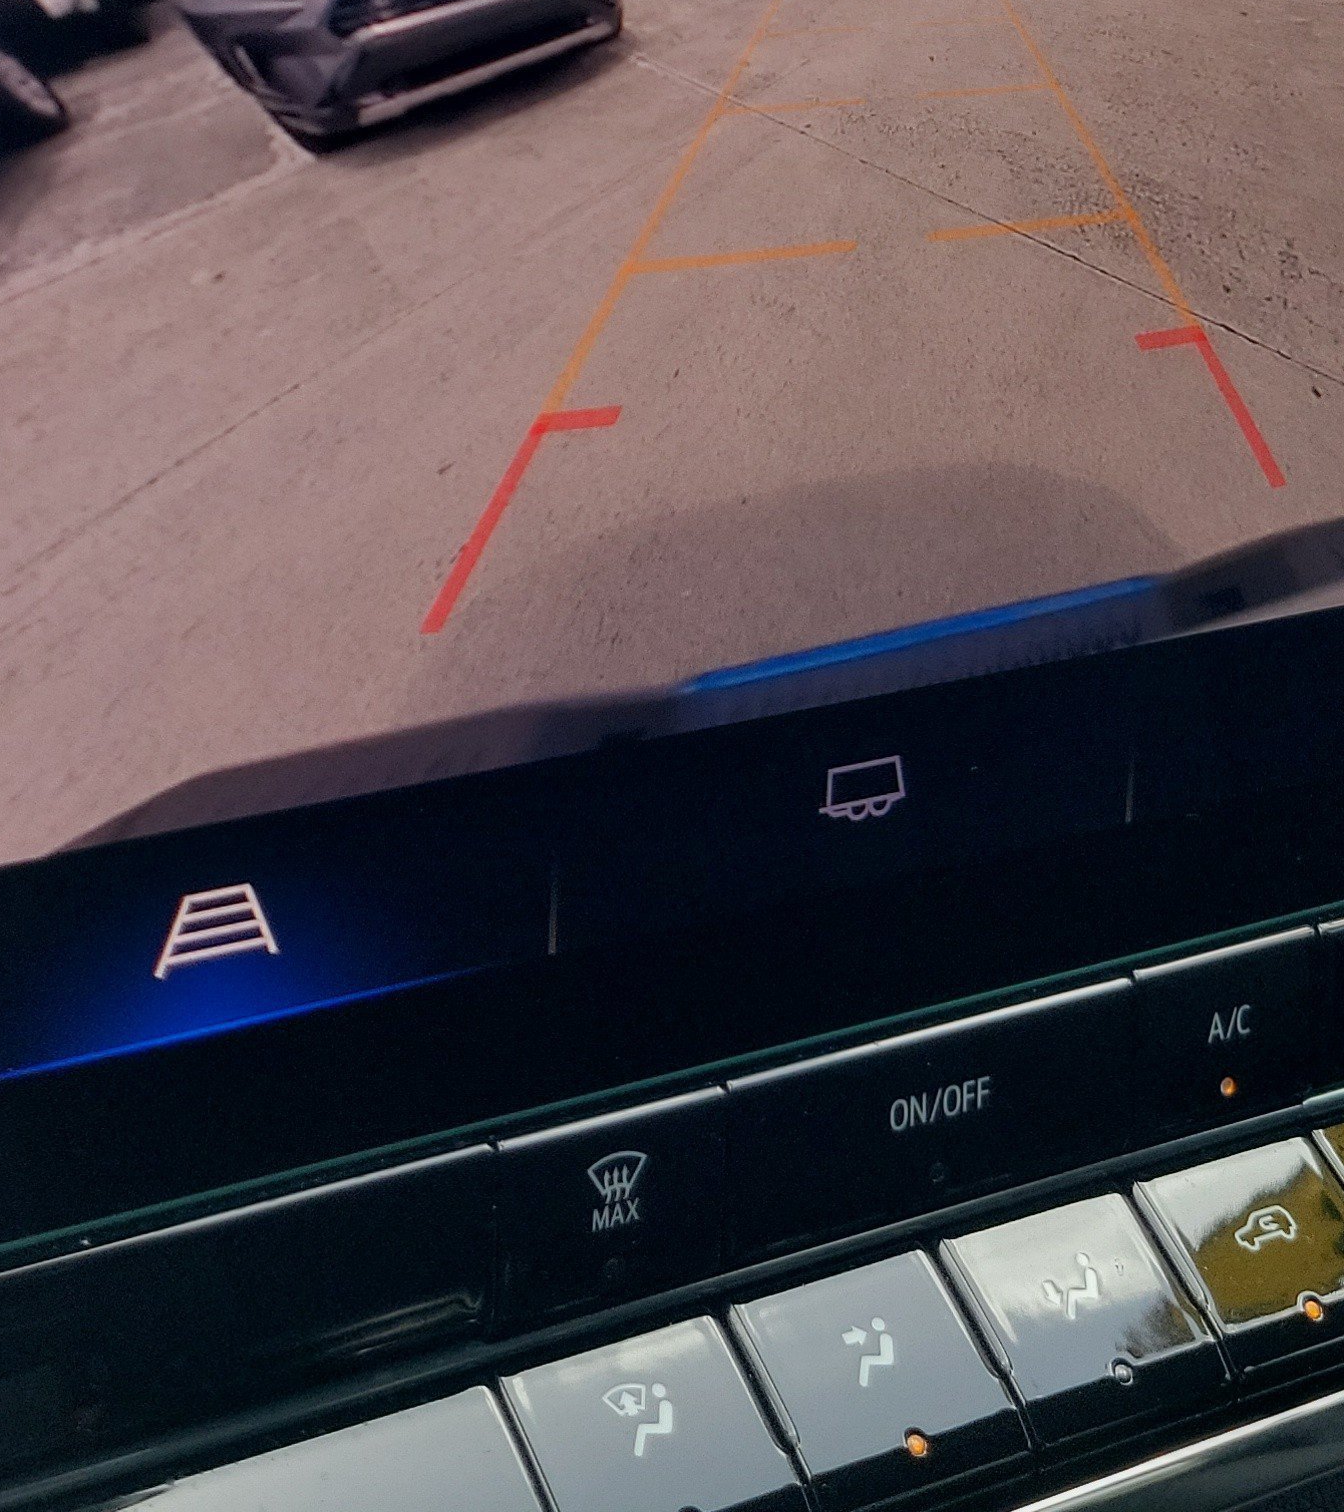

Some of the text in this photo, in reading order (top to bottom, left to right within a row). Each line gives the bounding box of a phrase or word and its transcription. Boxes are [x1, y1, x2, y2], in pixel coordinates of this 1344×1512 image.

[1207, 1003, 1251, 1044] A/C
[889, 1075, 991, 1131] ON/OFF
[591, 1197, 641, 1232] MAX
